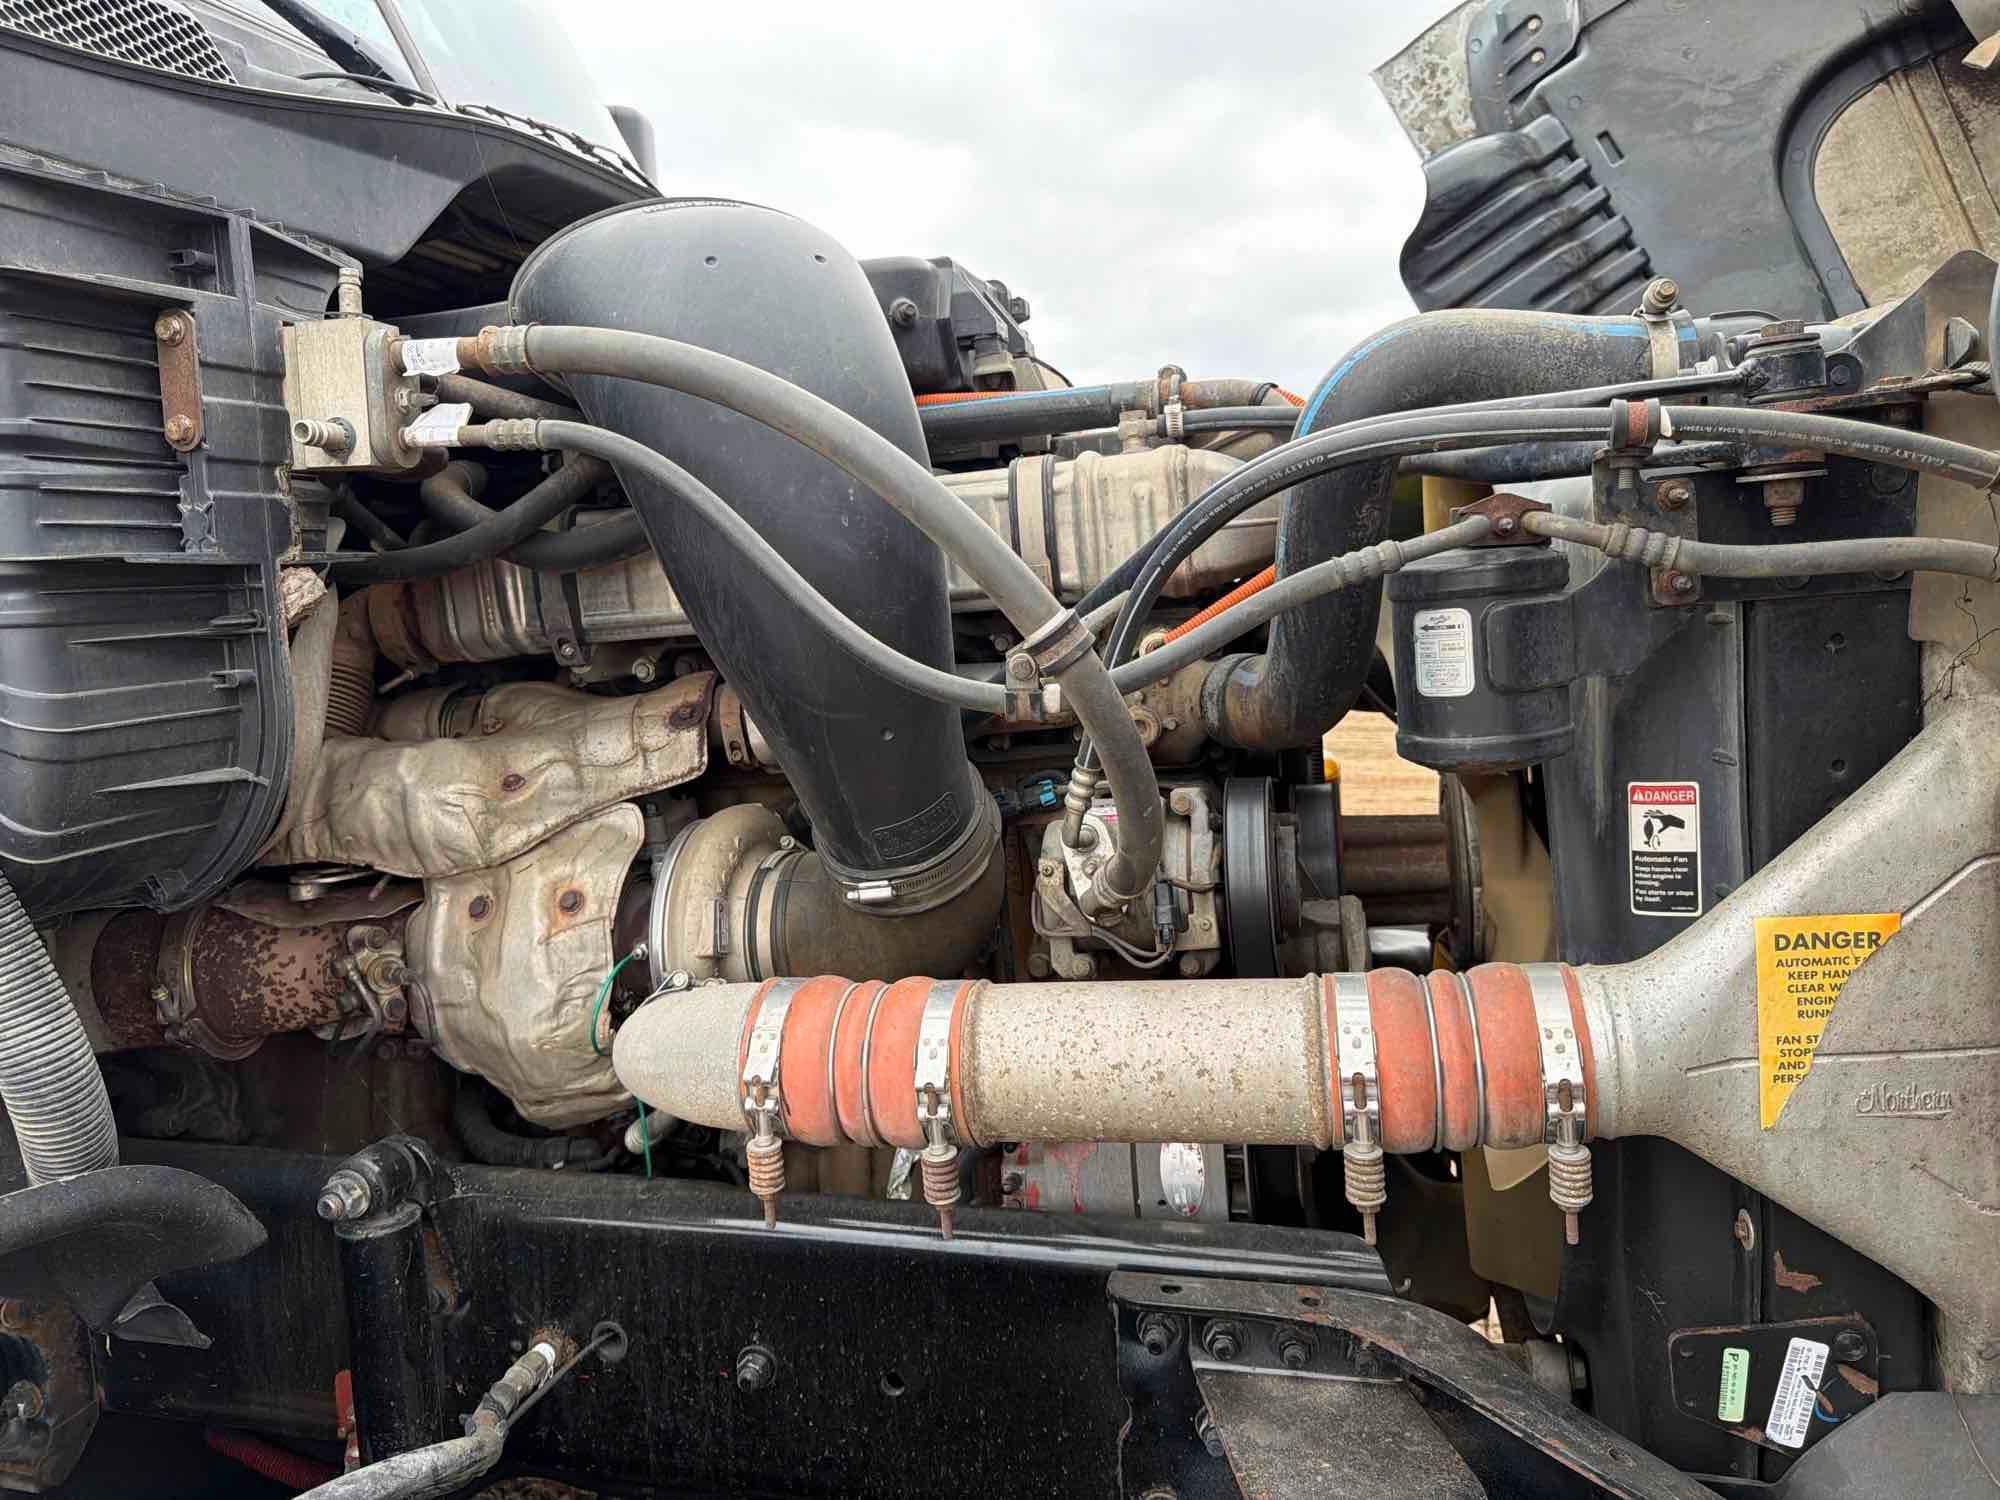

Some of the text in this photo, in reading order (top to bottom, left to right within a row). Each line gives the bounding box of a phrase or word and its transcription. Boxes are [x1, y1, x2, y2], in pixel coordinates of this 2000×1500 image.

[1286, 454, 1324, 475] GALAXY
[1644, 790, 1695, 802] DANGER
[1634, 855, 1688, 863] Automatic Fan
[1773, 931, 1882, 952] DANGER
[1775, 956, 1850, 968] AUTOMATIC
[1788, 970, 1818, 981] KEEP
[1787, 983, 1825, 994] CLEAR
[1776, 1034, 1820, 1046] FAN ST
[1779, 1047, 1813, 1058] STOP
[1778, 1061, 1806, 1071] AND
